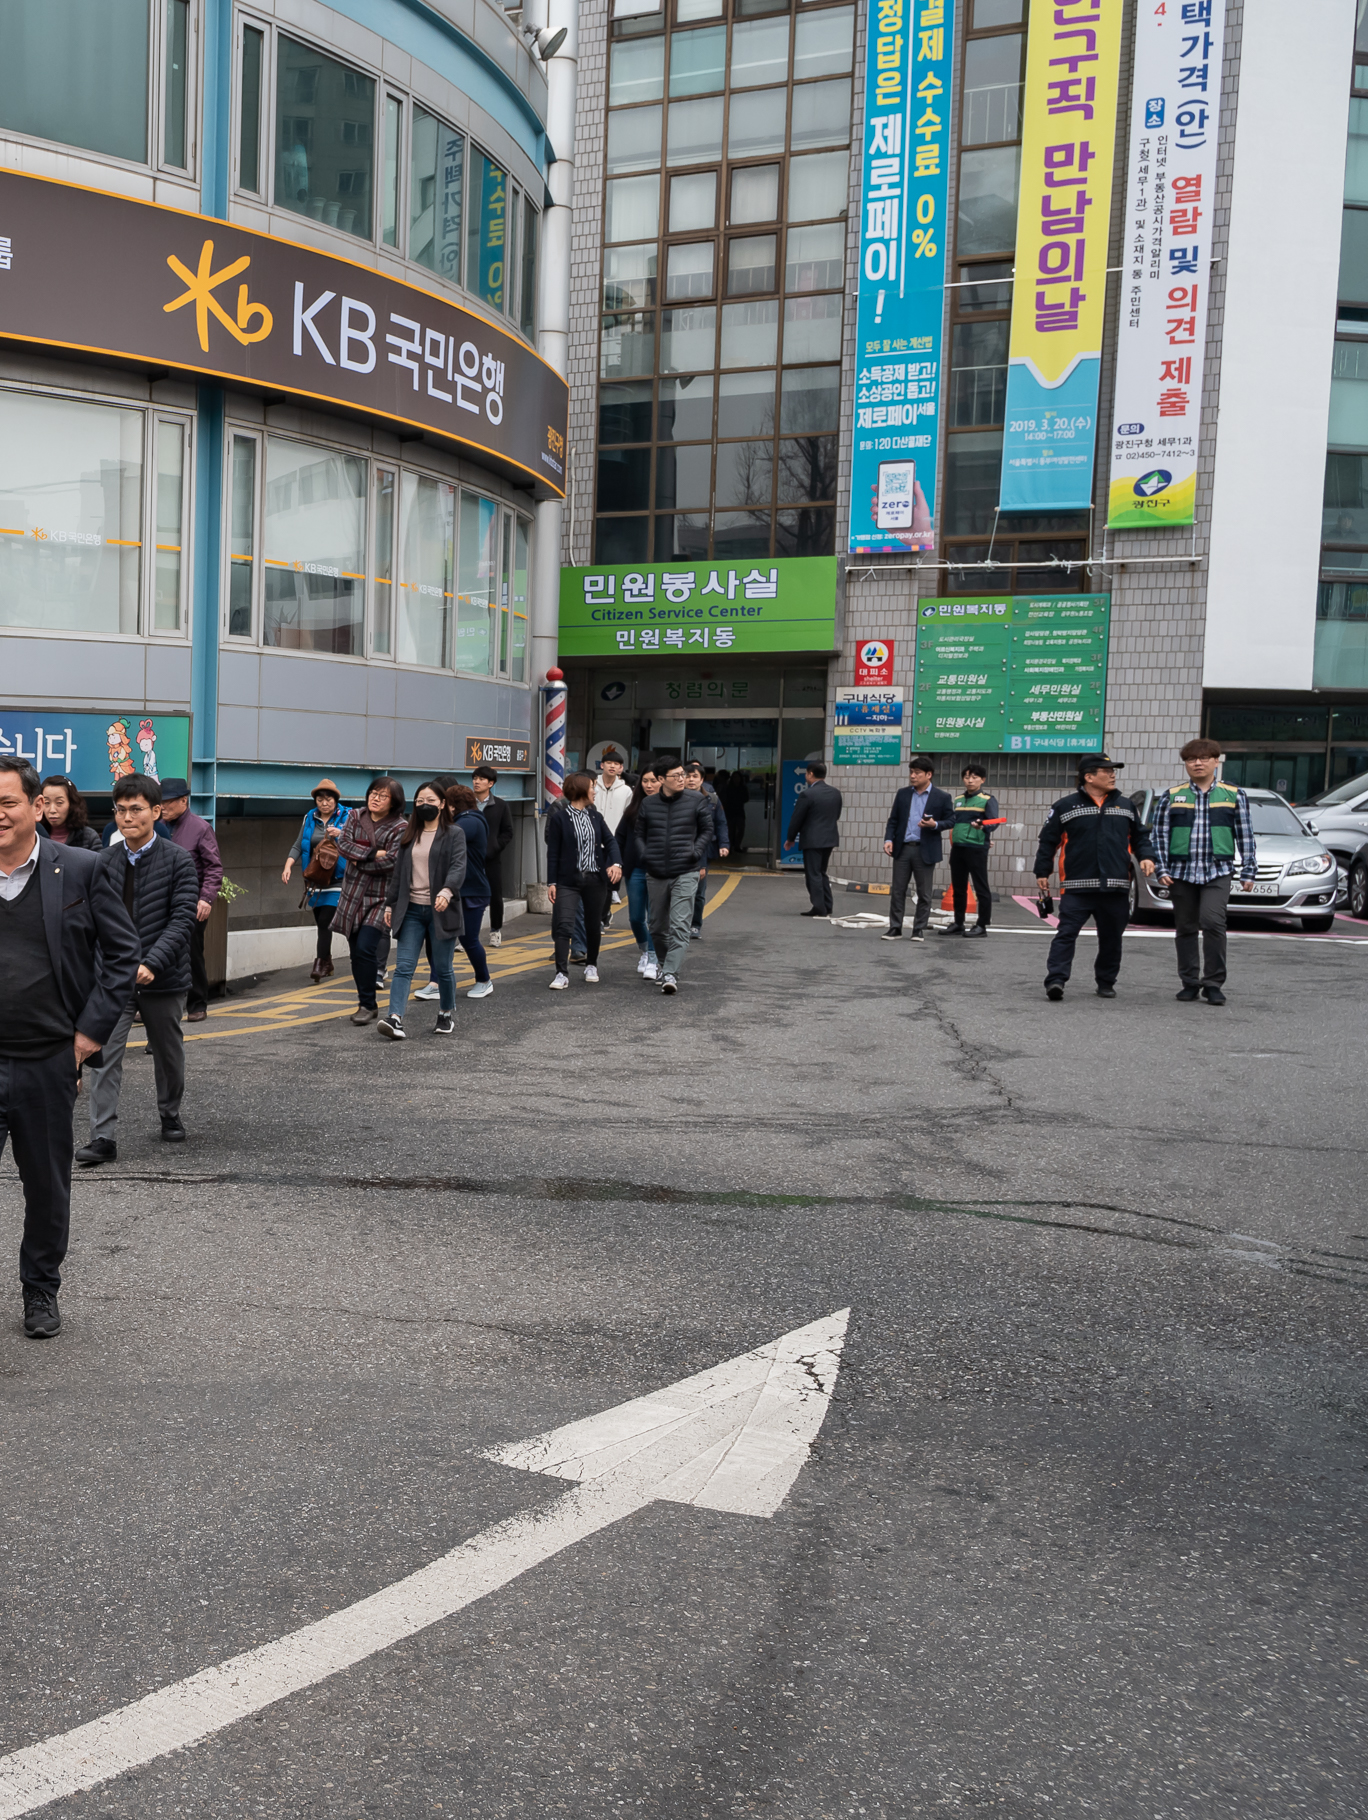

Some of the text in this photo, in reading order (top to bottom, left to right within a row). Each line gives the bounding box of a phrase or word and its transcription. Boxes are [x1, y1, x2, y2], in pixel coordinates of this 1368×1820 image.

[1147, 98, 1164, 126] 장소
[914, 71, 943, 177] 수수료
[1156, 135, 1168, 168] 인터넷
[1170, 174, 1202, 236] 열람
[912, 194, 937, 258] 0%
[1135, 219, 1145, 230] 및
[1169, 245, 1199, 276] 및
[1129, 285, 1142, 328] 주민센터
[1165, 284, 1198, 345] 의견
[865, 340, 881, 352] 모두
[892, 338, 908, 350] 사는
[909, 336, 933, 349] 계산법
[292, 281, 505, 426] KB국민은행
[858, 362, 937, 384] 소득공제 받고!
[857, 381, 936, 403] 소상공인 돕고!
[1157, 356, 1192, 417] 제출
[857, 402, 935, 428] 제로페이 서울
[1009, 420, 1038, 432] 2019.
[1041, 419, 1050, 430] 3.
[1120, 424, 1140, 434] 문의
[875, 437, 891, 450] 120
[1115, 436, 1192, 450] 광진구청 세무1과
[1132, 499, 1171, 509] 광진구
[583, 568, 779, 604] 민원봉사실
[591, 605, 763, 621] Citizen Service Center
[939, 603, 1007, 616] 민원복지동
[616, 627, 736, 650] 민원복지동
[859, 668, 888, 676] 대피소
[936, 674, 988, 685] 교통민원실
[665, 681, 749, 699] 청렴의 문
[1029, 684, 1082, 695] 세무민원실
[843, 693, 896, 704] 구내식당
[936, 717, 985, 728] 민원봉사실
[1030, 711, 1084, 722] 부동산민원실
[1011, 736, 1031, 749] B1
[1033, 738, 1065, 747] 구내식당
